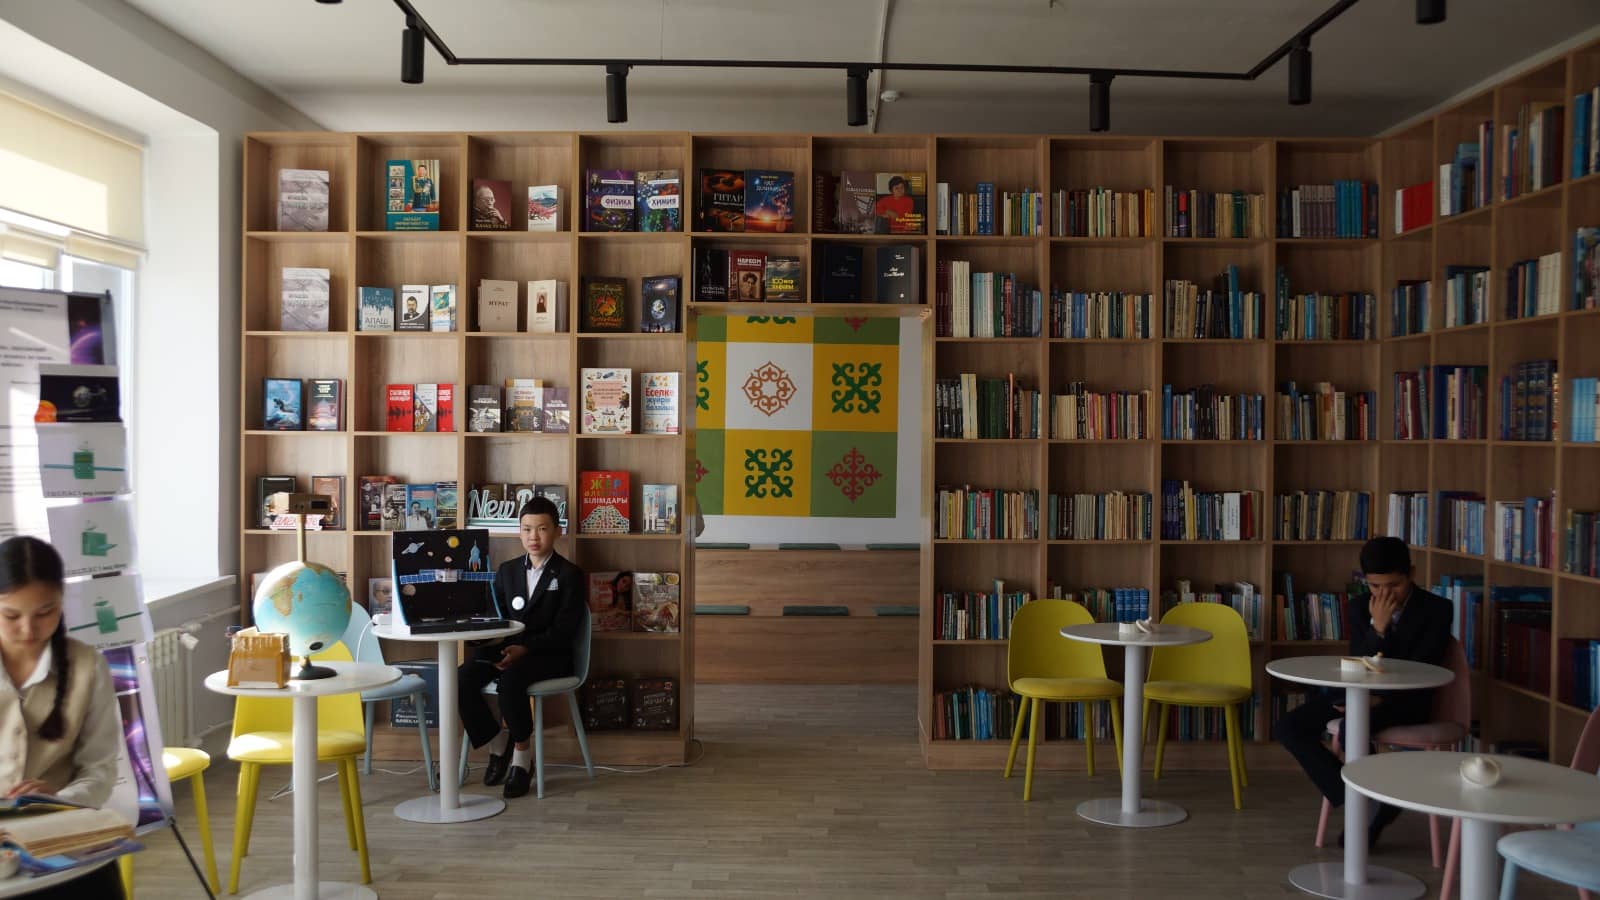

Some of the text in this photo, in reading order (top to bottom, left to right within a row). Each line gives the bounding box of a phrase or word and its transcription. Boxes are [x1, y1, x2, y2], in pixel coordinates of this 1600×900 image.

[605, 198, 632, 206] ФИЗИКА
[652, 198, 676, 206] ХИМИЯ
[591, 480, 622, 490] ЖЕР
[467, 489, 515, 519] New
